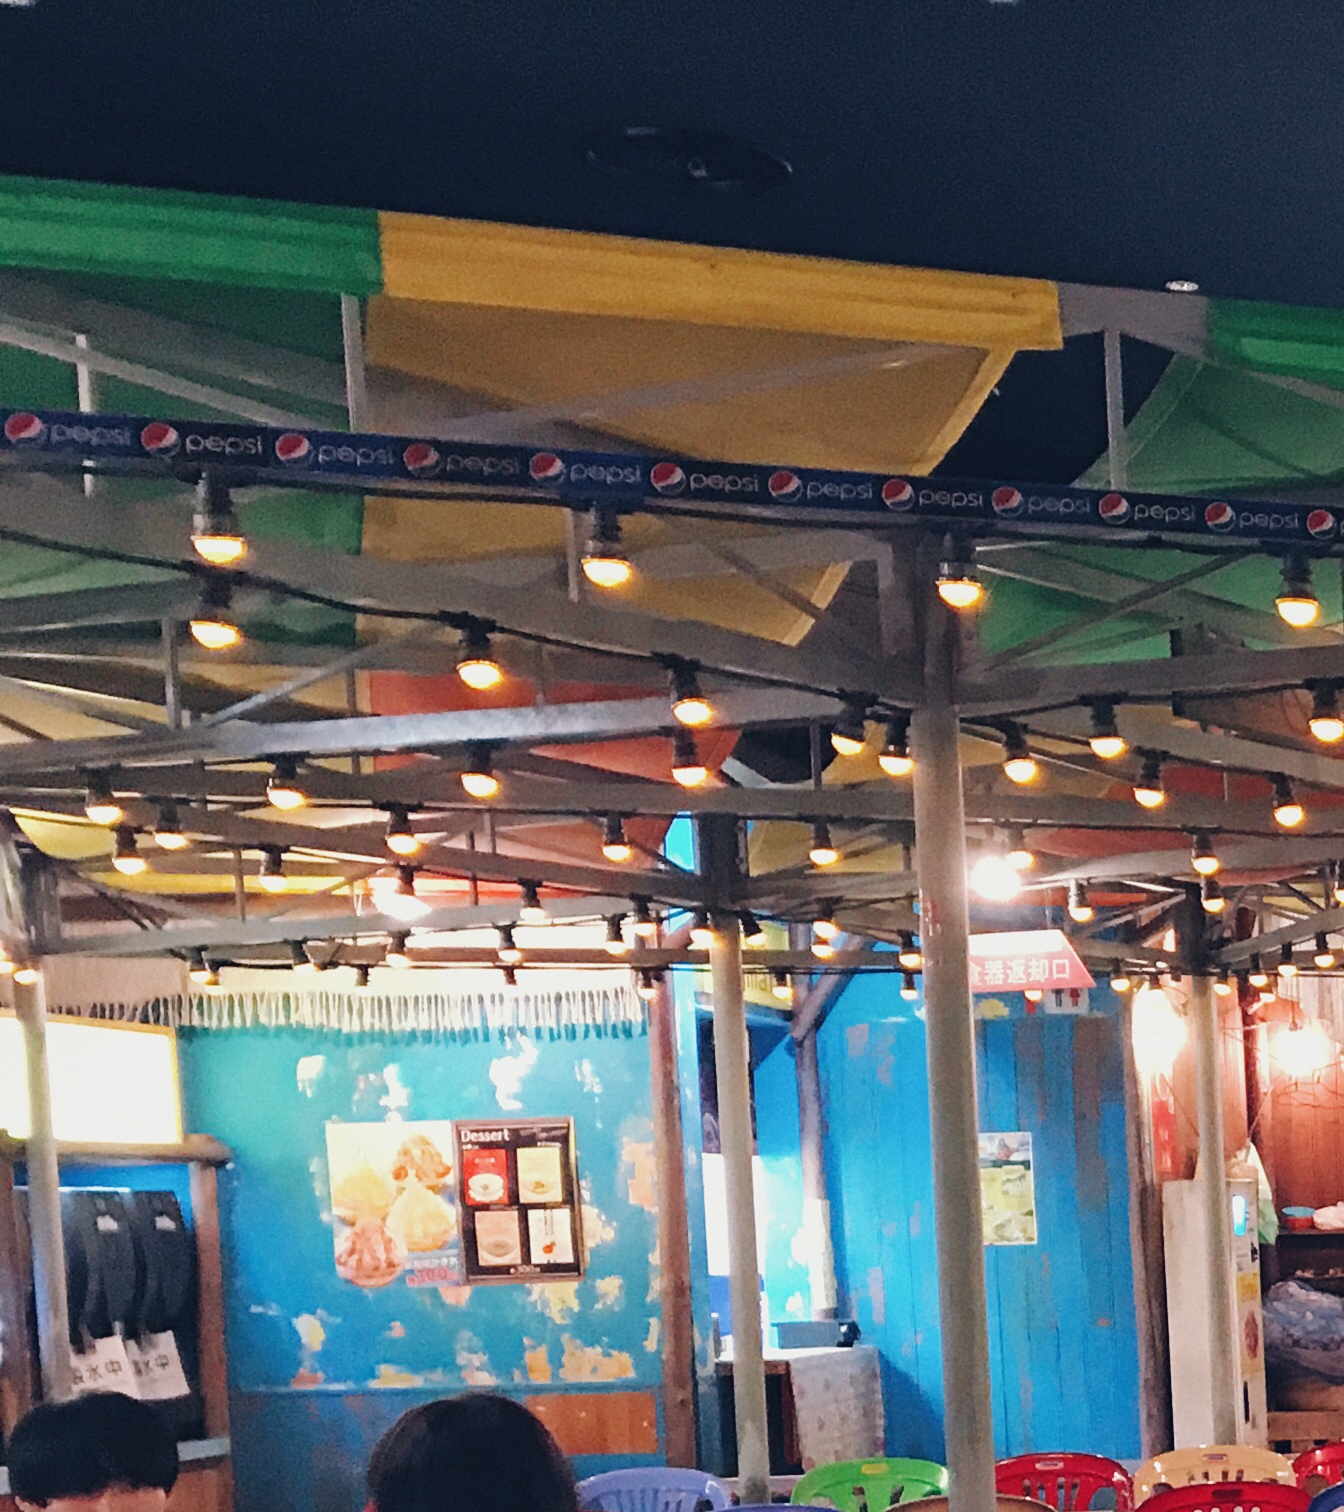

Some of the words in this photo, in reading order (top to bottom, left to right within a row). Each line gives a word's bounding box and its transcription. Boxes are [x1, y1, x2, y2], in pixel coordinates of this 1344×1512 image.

[50, 423, 131, 447] pepsi
[186, 434, 263, 456] pepsi
[318, 444, 394, 466] pepsi
[446, 453, 520, 475] pepsi
[570, 463, 641, 484] pepsi
[690, 472, 759, 493] pepsi
[806, 480, 873, 500] pepsi
[918, 488, 983, 508] pepsi
[1027, 495, 1090, 514] pepsi
[1134, 503, 1196, 522] pepsi
[1239, 511, 1299, 530] pepsi
[461, 1128, 510, 1142] Dessert
